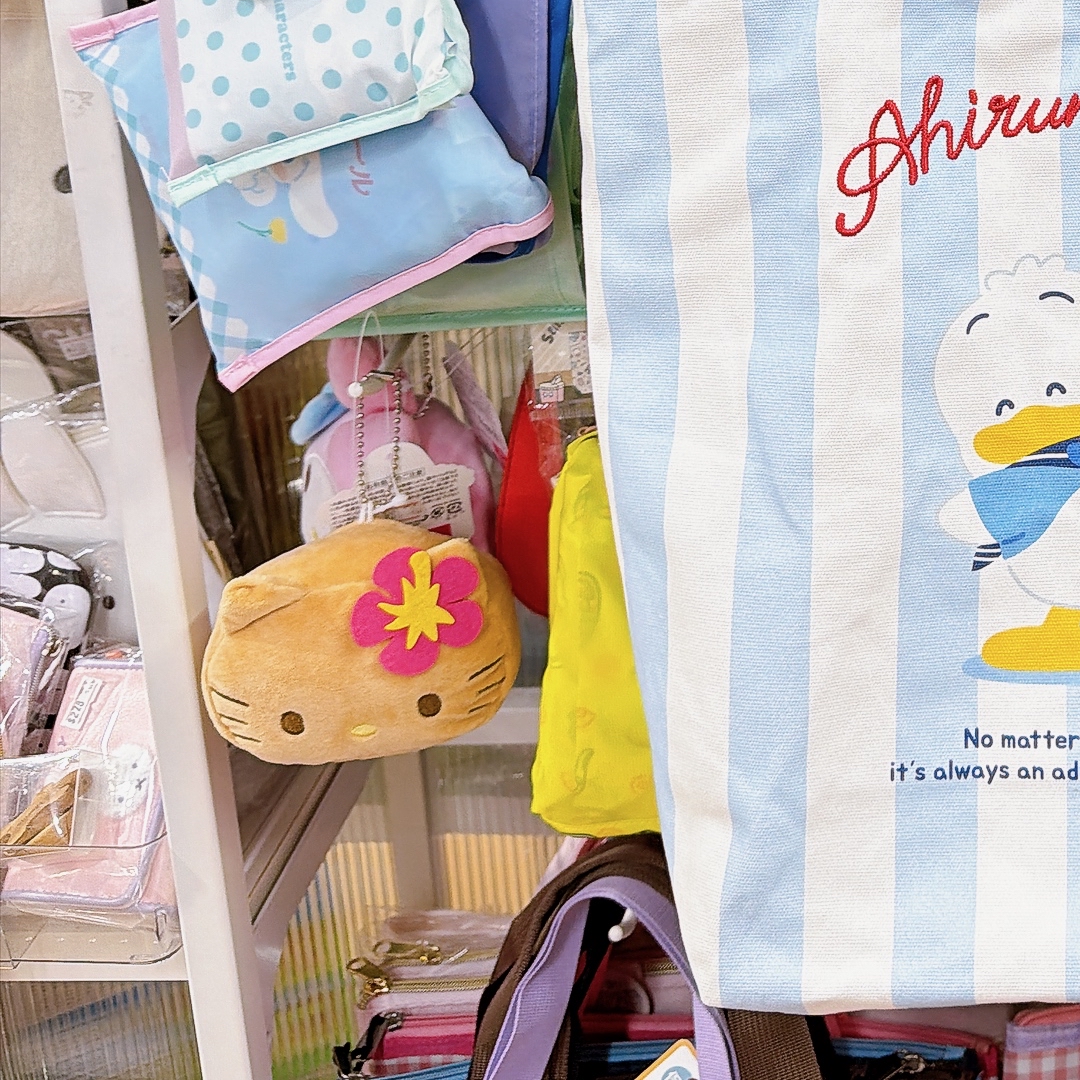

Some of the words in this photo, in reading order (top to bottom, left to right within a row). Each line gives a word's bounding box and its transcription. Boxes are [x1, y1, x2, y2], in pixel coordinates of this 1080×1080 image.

[963, 727, 994, 749] No
[1001, 729, 1080, 750] matter
[889, 760, 926, 781] it's
[933, 759, 1009, 785] always
[1017, 765, 1045, 781] an
